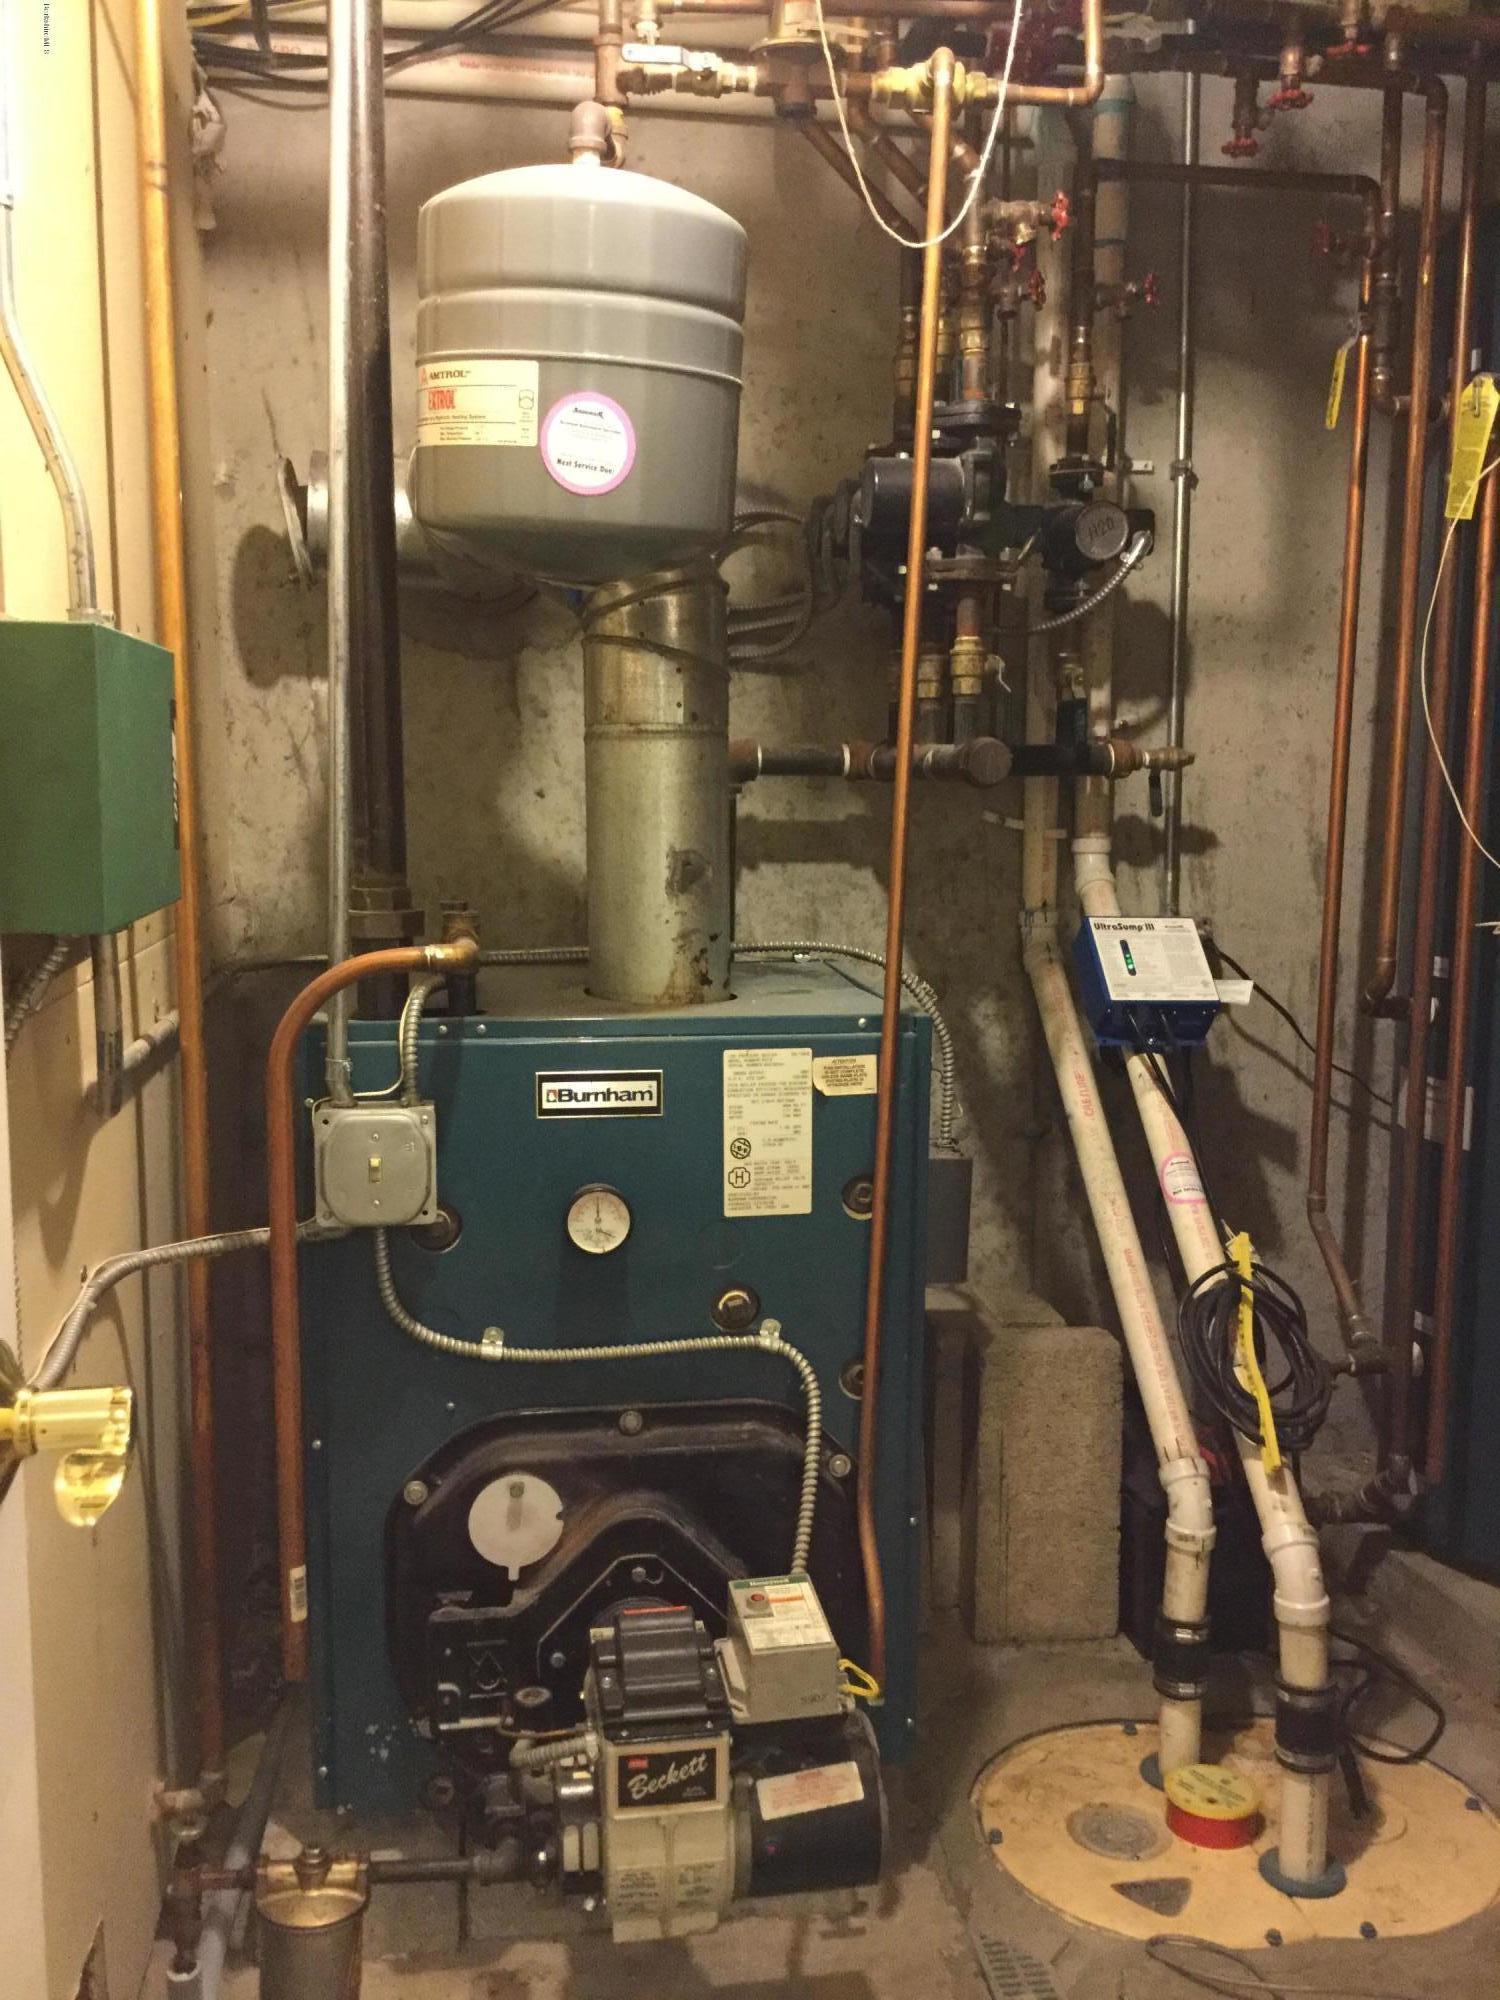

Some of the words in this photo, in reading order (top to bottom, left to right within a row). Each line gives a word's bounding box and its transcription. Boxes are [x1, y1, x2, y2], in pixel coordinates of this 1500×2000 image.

[429, 369, 467, 380] AMTROL
[574, 460, 598, 472] Service
[1093, 922, 1143, 932] UltraSump
[557, 1087, 653, 1103] Burnham
[627, 1752, 708, 1800] Beckett
